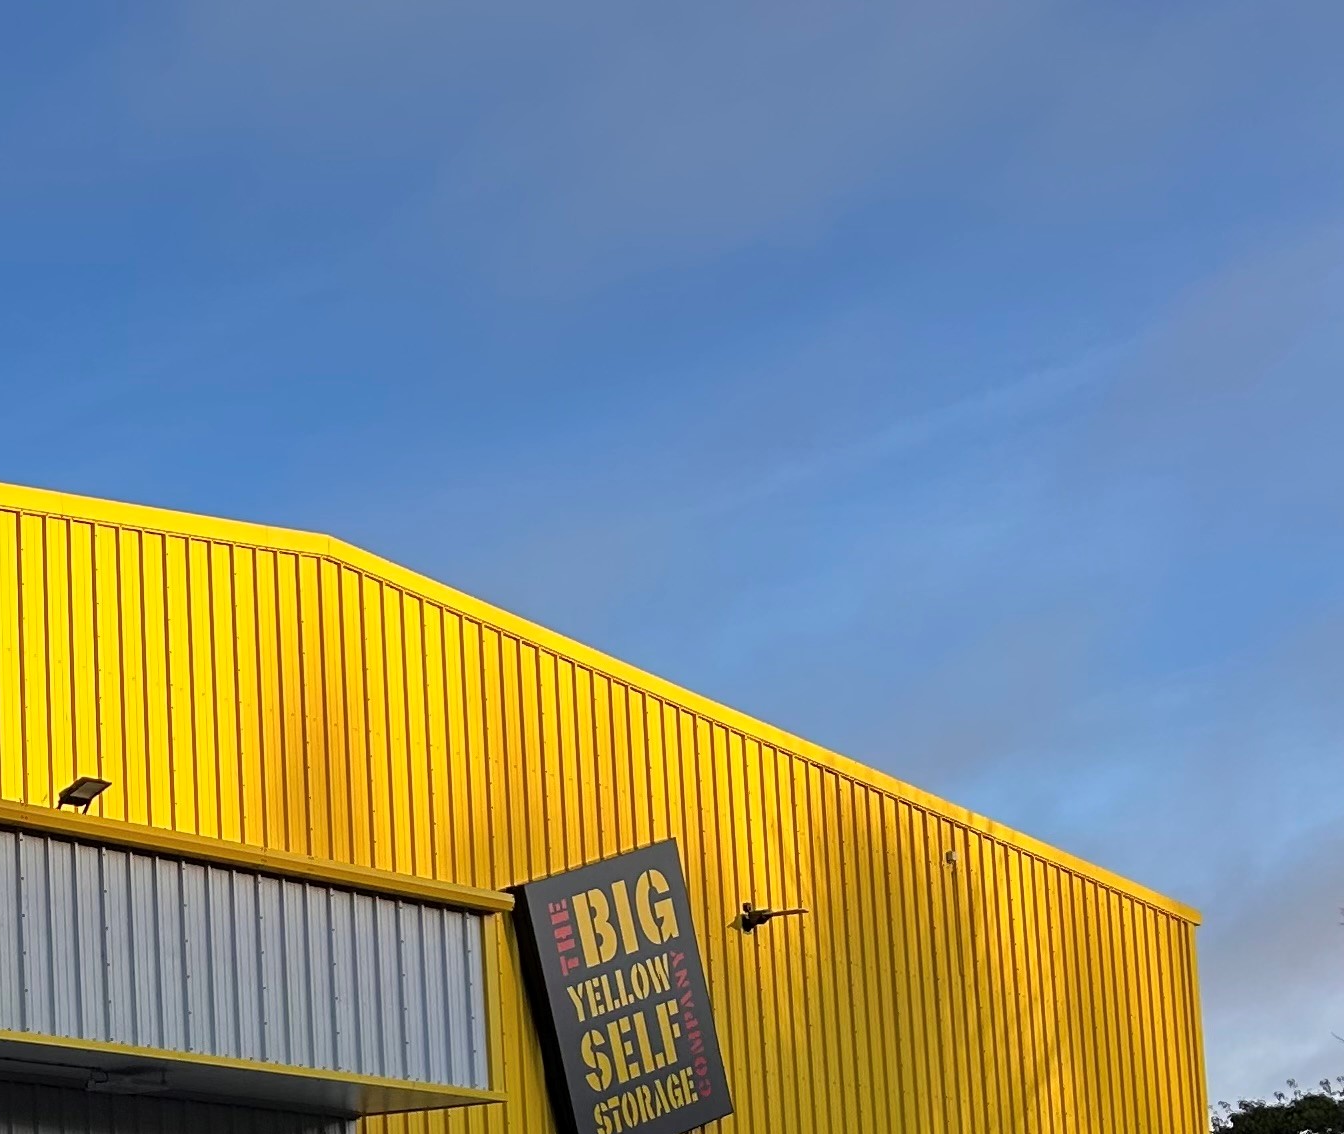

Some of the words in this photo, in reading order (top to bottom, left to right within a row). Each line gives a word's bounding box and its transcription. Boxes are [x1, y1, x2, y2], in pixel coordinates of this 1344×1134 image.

[548, 897, 580, 977] THE
[571, 869, 679, 968] BIG
[567, 953, 671, 1022] YELLOW
[670, 950, 711, 1097] COMPANY
[580, 998, 681, 1093] SELF
